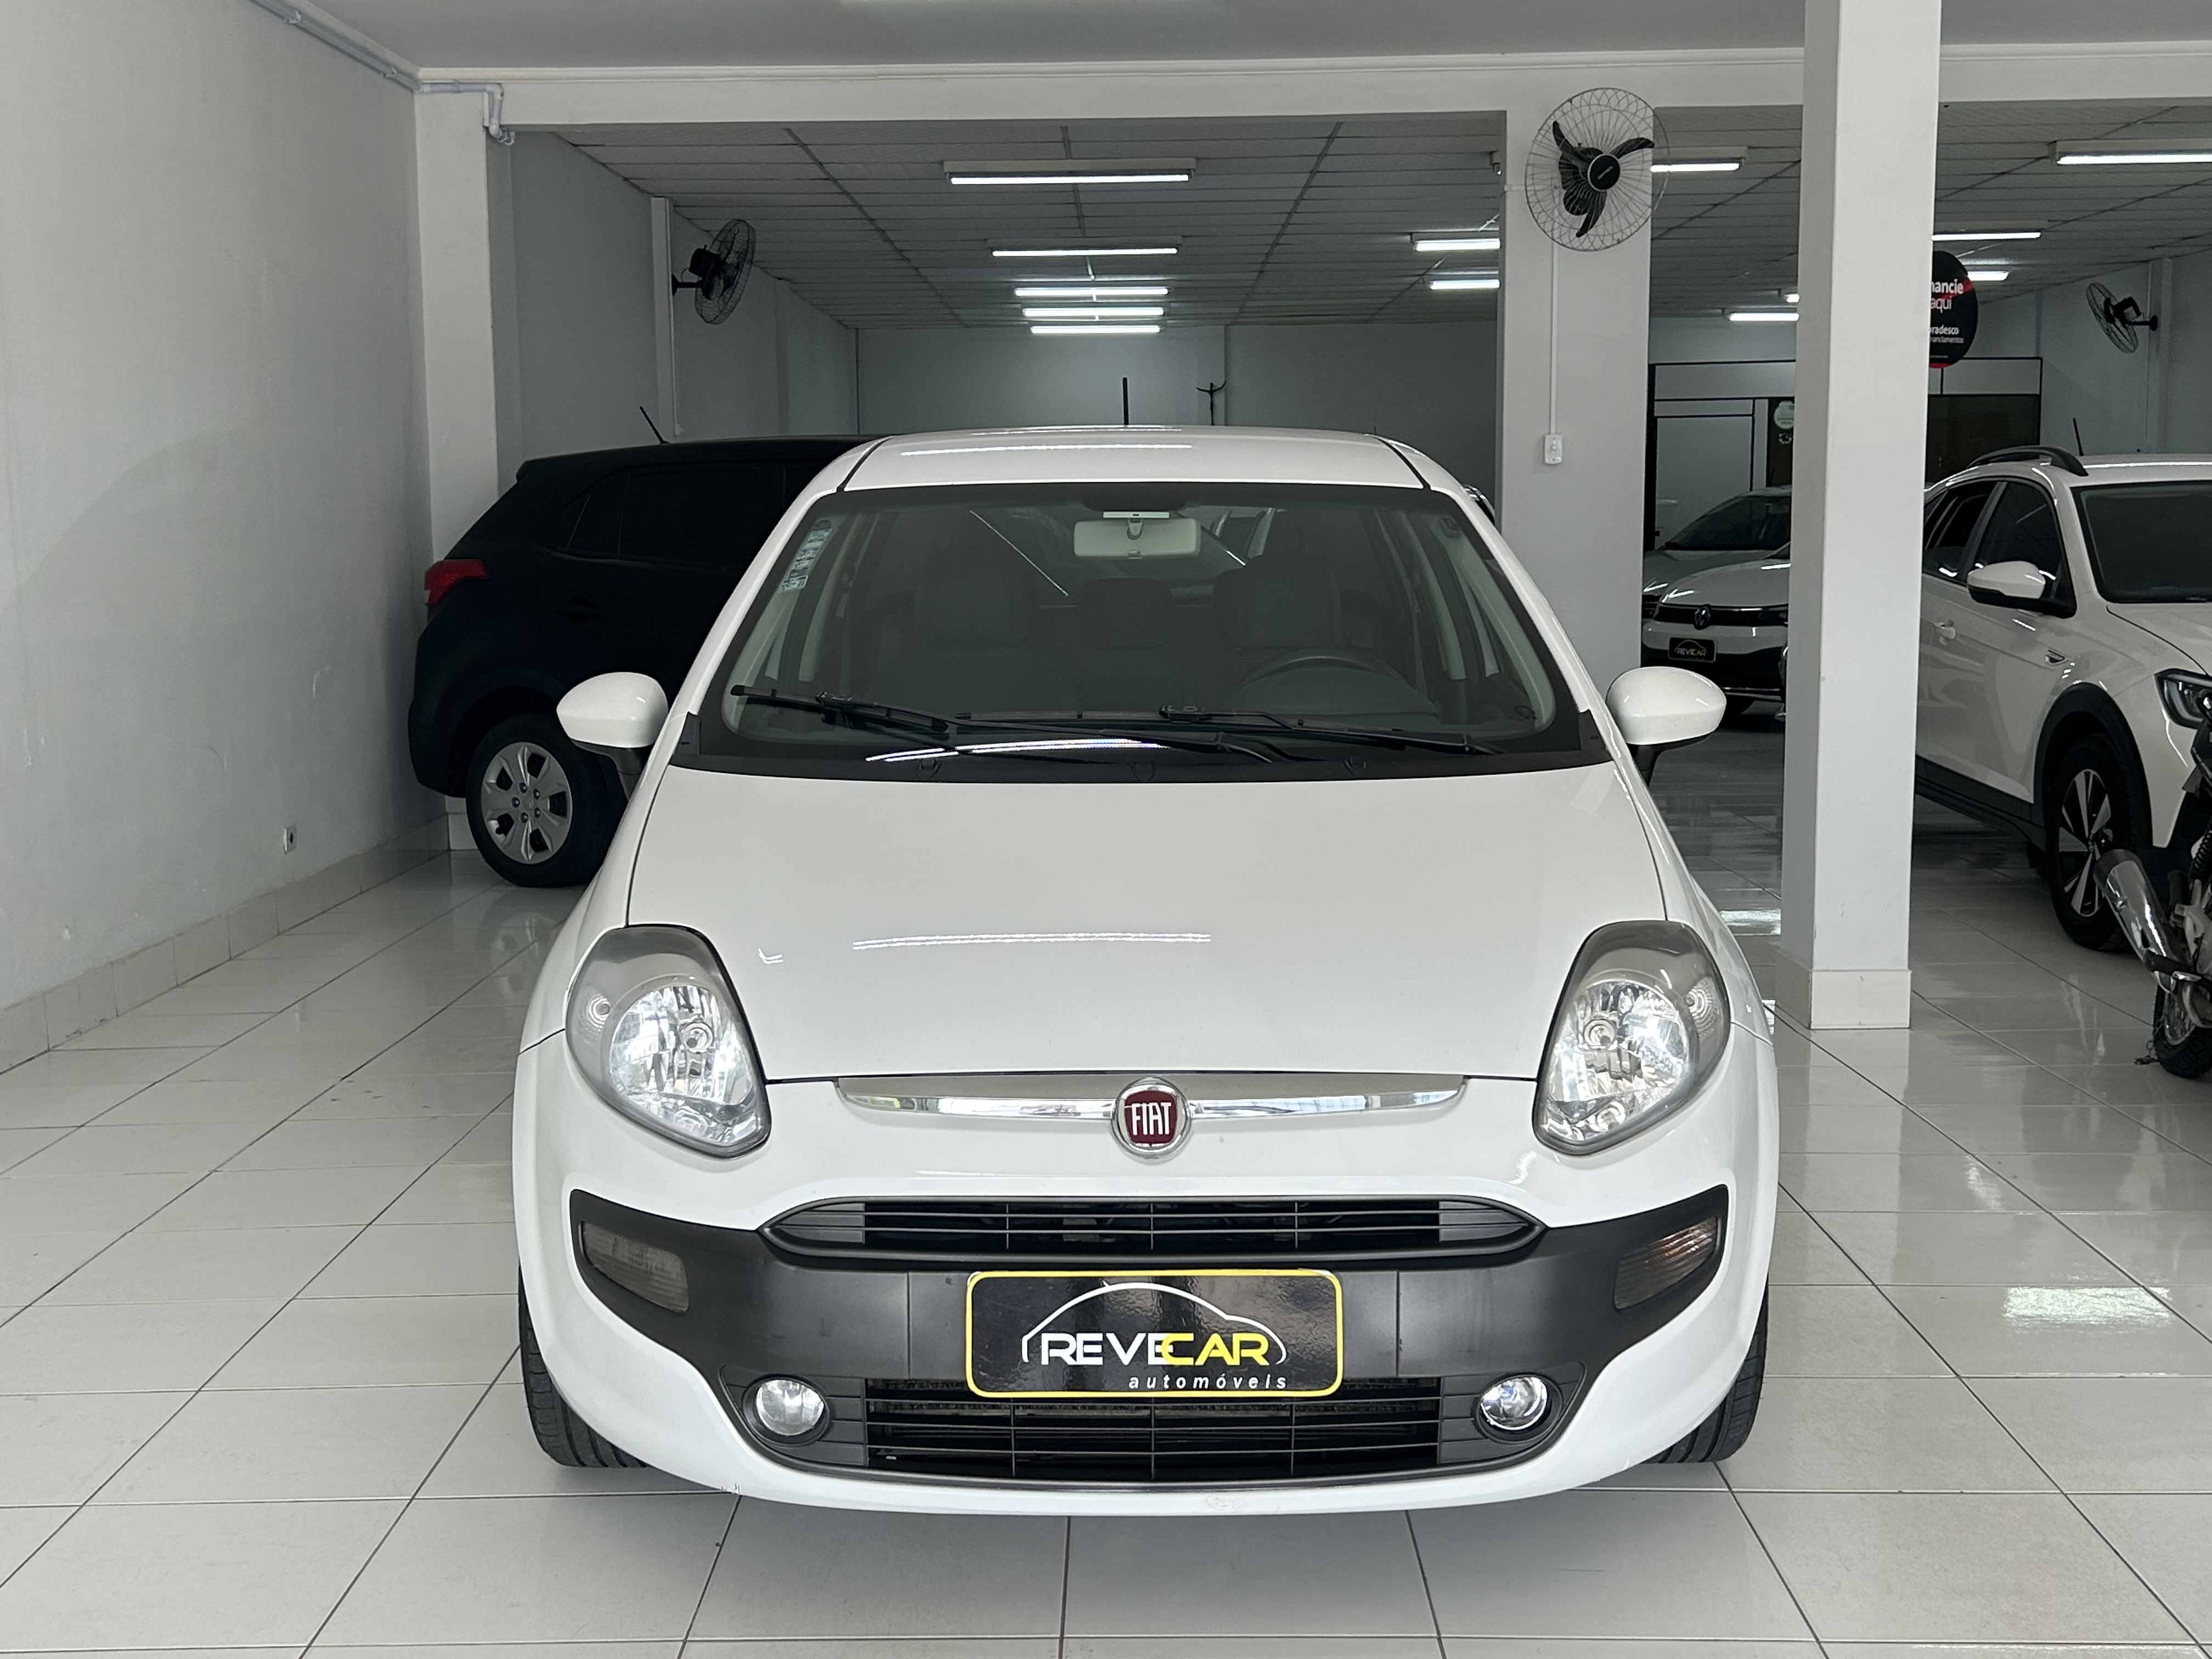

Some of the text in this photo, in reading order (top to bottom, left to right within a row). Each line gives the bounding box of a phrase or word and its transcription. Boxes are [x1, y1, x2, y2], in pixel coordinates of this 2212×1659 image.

[1931, 295, 1953, 313] aqui
[1131, 1102, 1172, 1136] FIAT
[1041, 1332, 1269, 1366] REVECAR
[1128, 1372, 1287, 1390] automóveis
